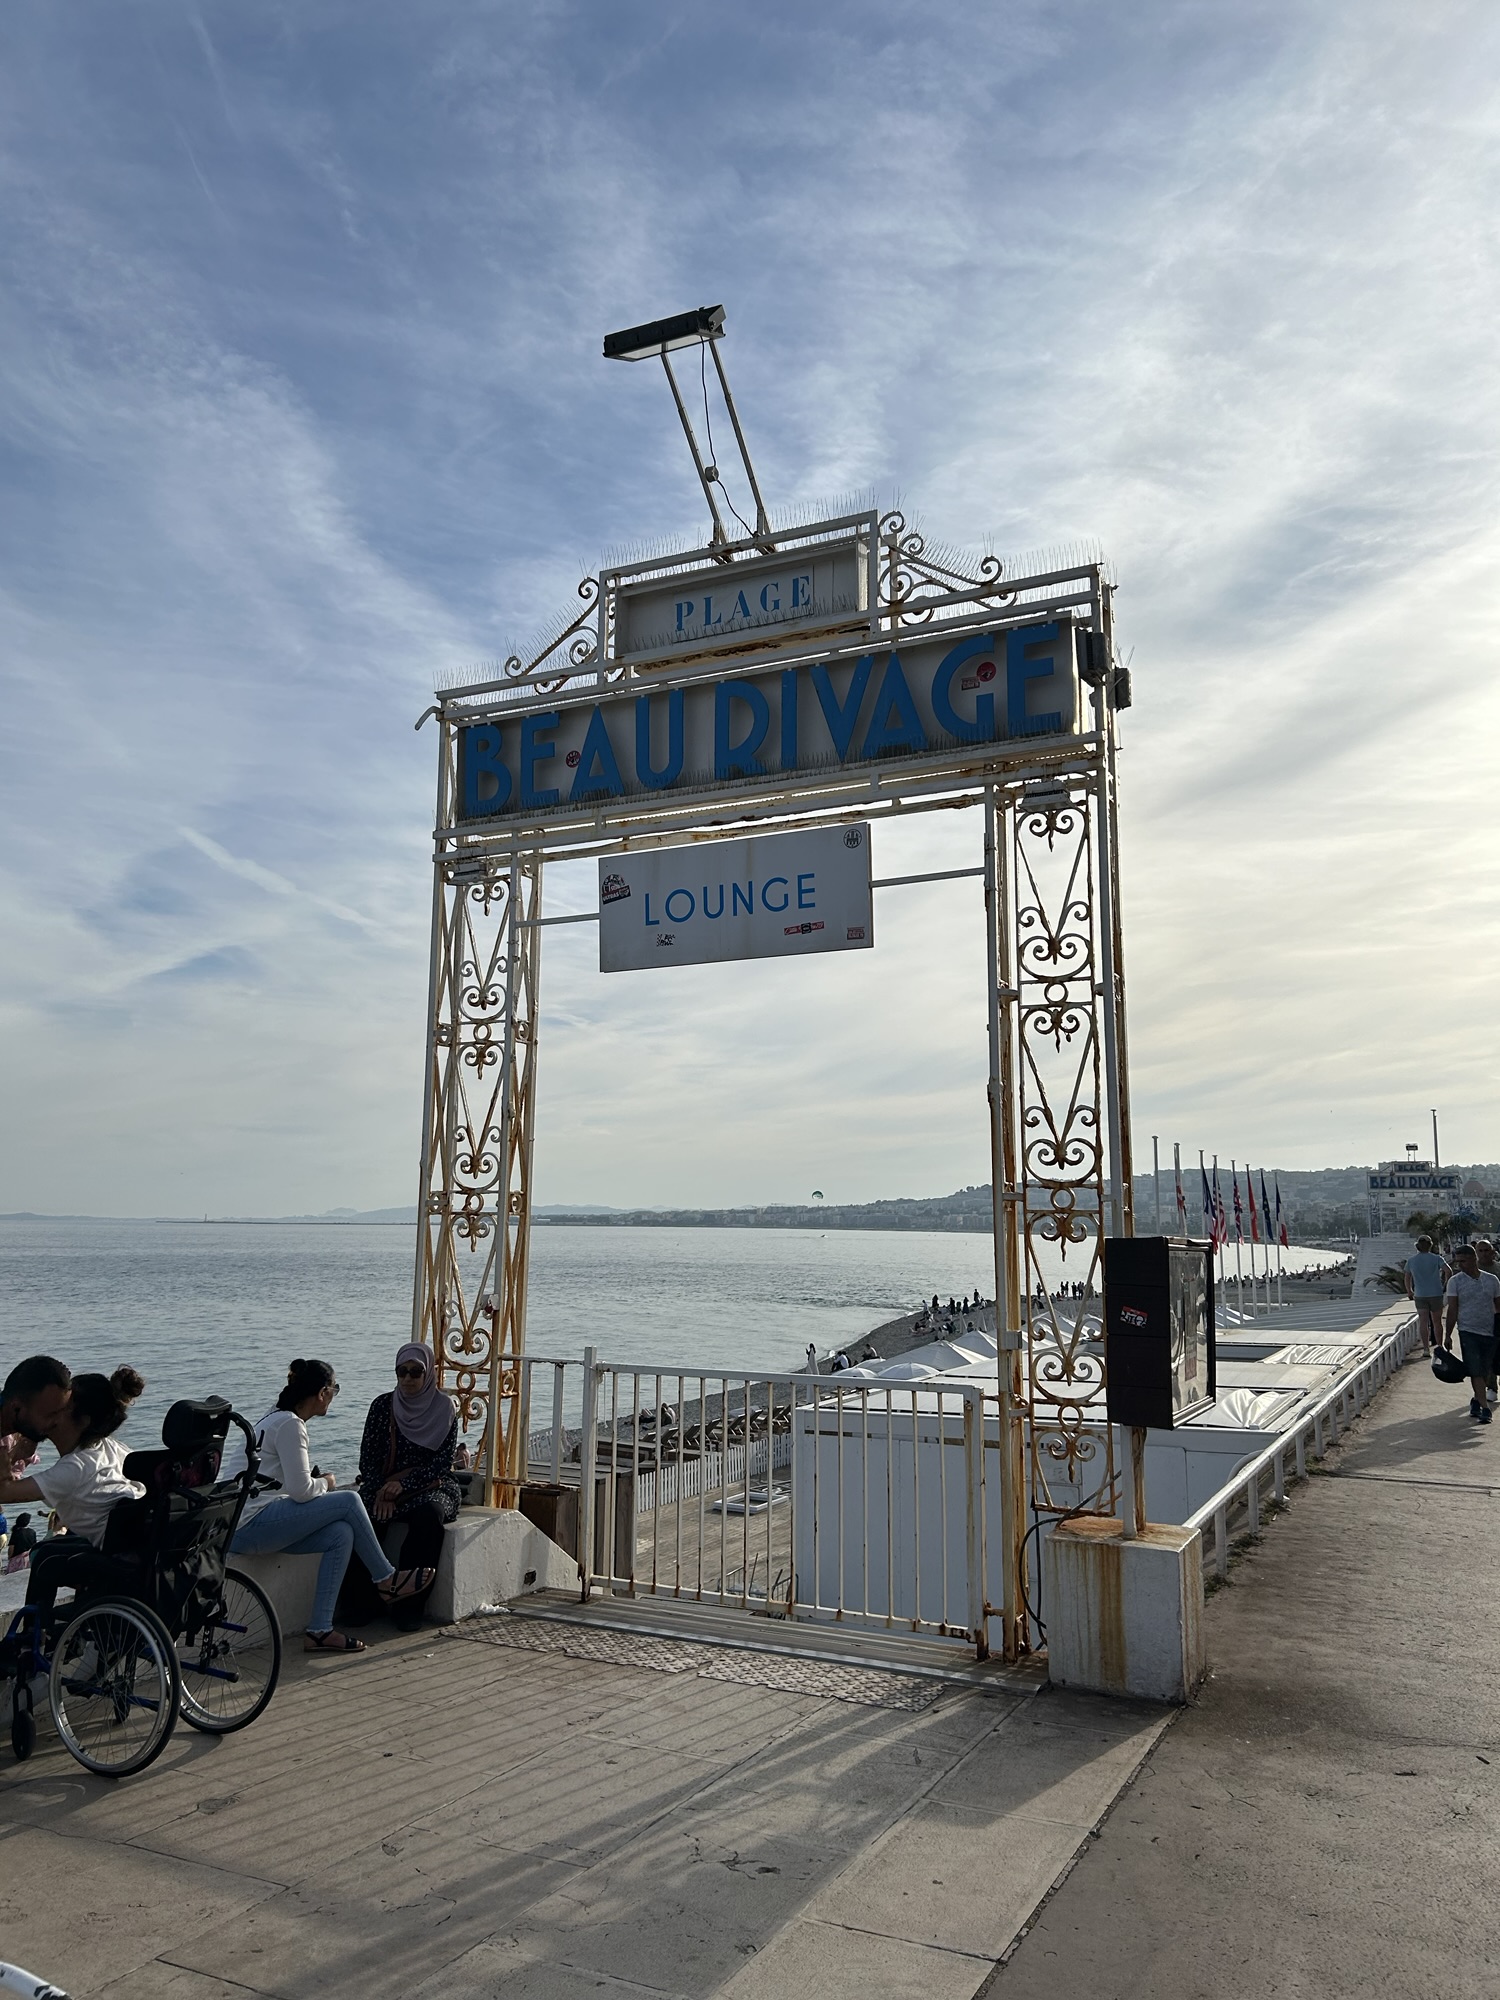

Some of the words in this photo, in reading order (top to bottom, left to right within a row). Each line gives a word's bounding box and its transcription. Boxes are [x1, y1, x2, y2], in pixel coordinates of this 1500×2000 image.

[675, 575, 811, 633] PLAGE
[465, 688, 685, 818] BEAU
[713, 621, 1063, 781] RIVAGE
[644, 872, 817, 926] LOUNGE
[1369, 1175, 1406, 1189] BEAU
[1409, 1175, 1457, 1189] RIVAGE
